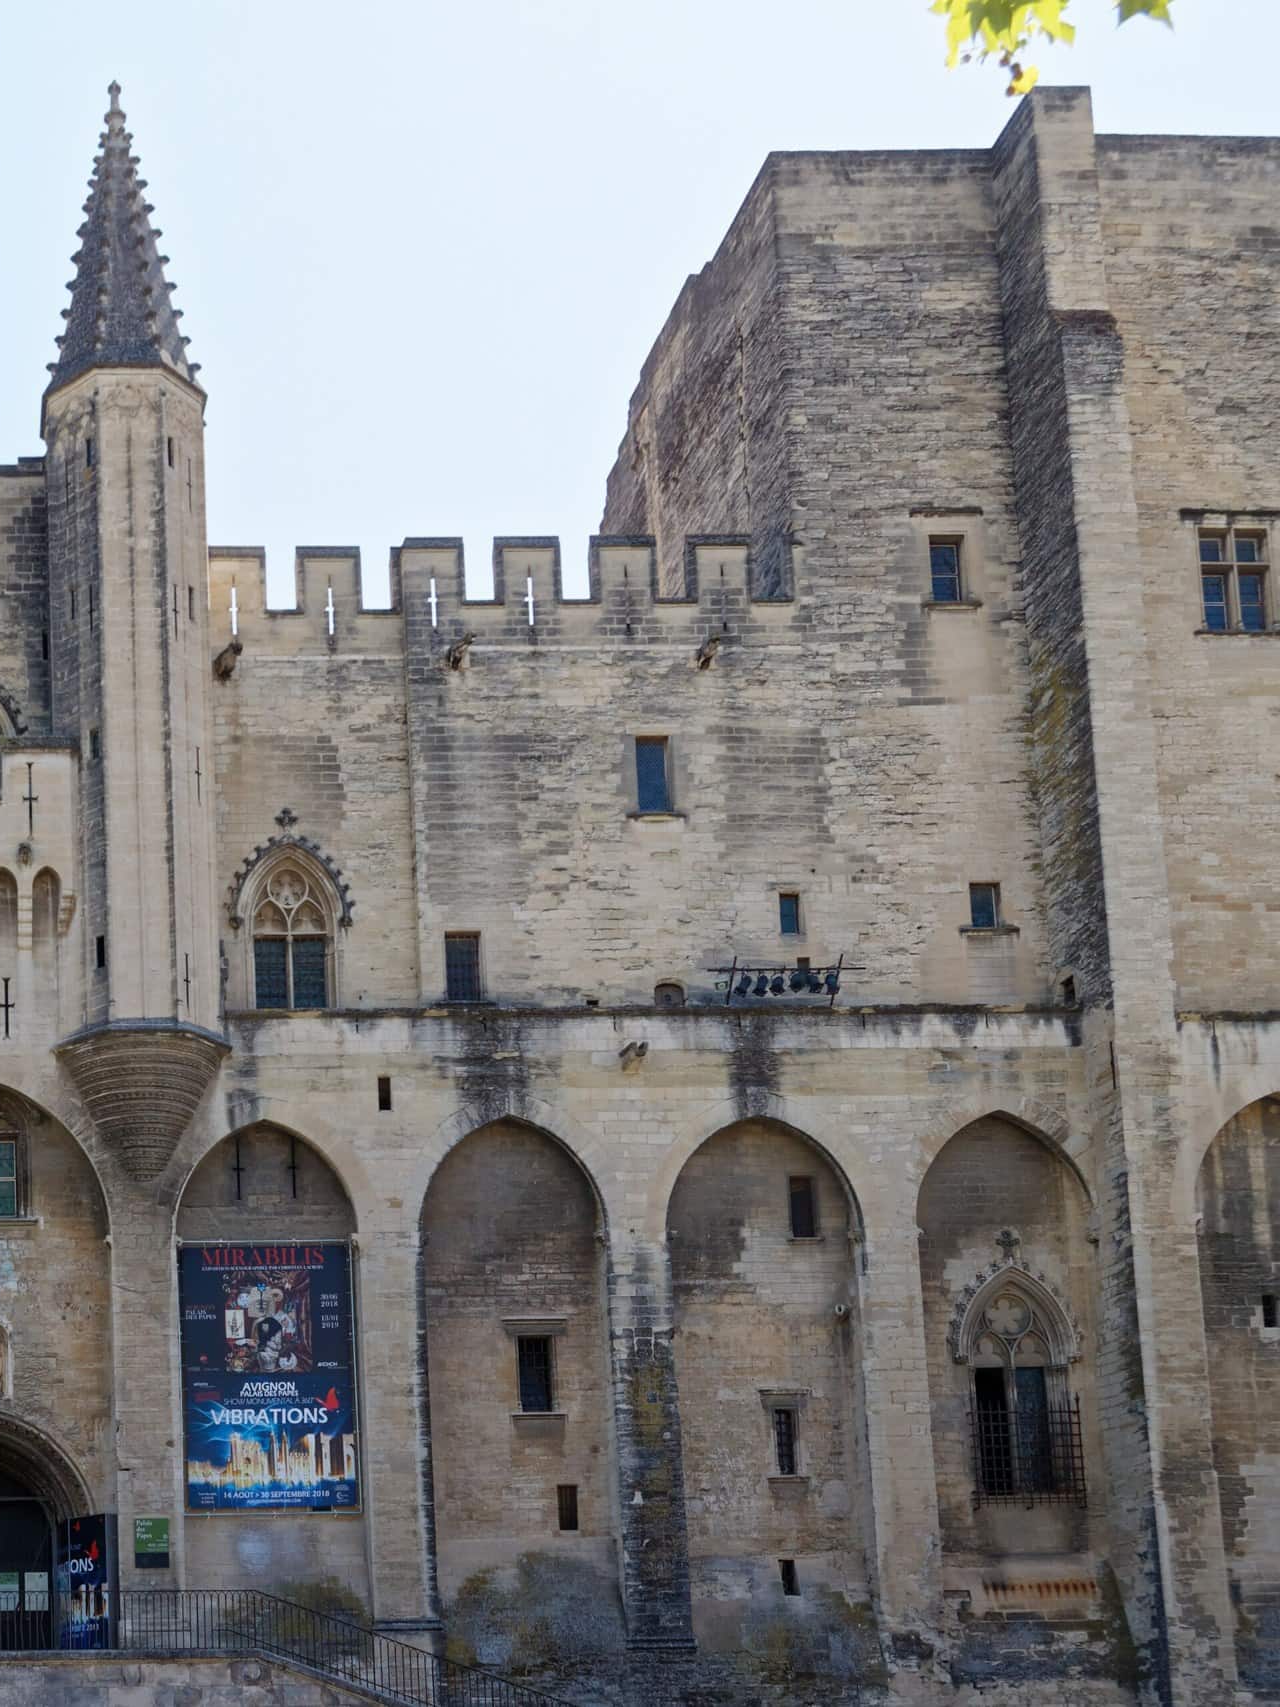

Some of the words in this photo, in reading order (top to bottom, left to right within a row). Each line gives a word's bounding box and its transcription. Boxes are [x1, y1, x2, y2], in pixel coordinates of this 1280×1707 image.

[201, 1247, 324, 1265] MIRABILIS
[242, 1381, 296, 1391] AVIGNON
[210, 1407, 329, 1425] VIBRATIONS
[271, 1490, 310, 1498] SEPTEMBRE
